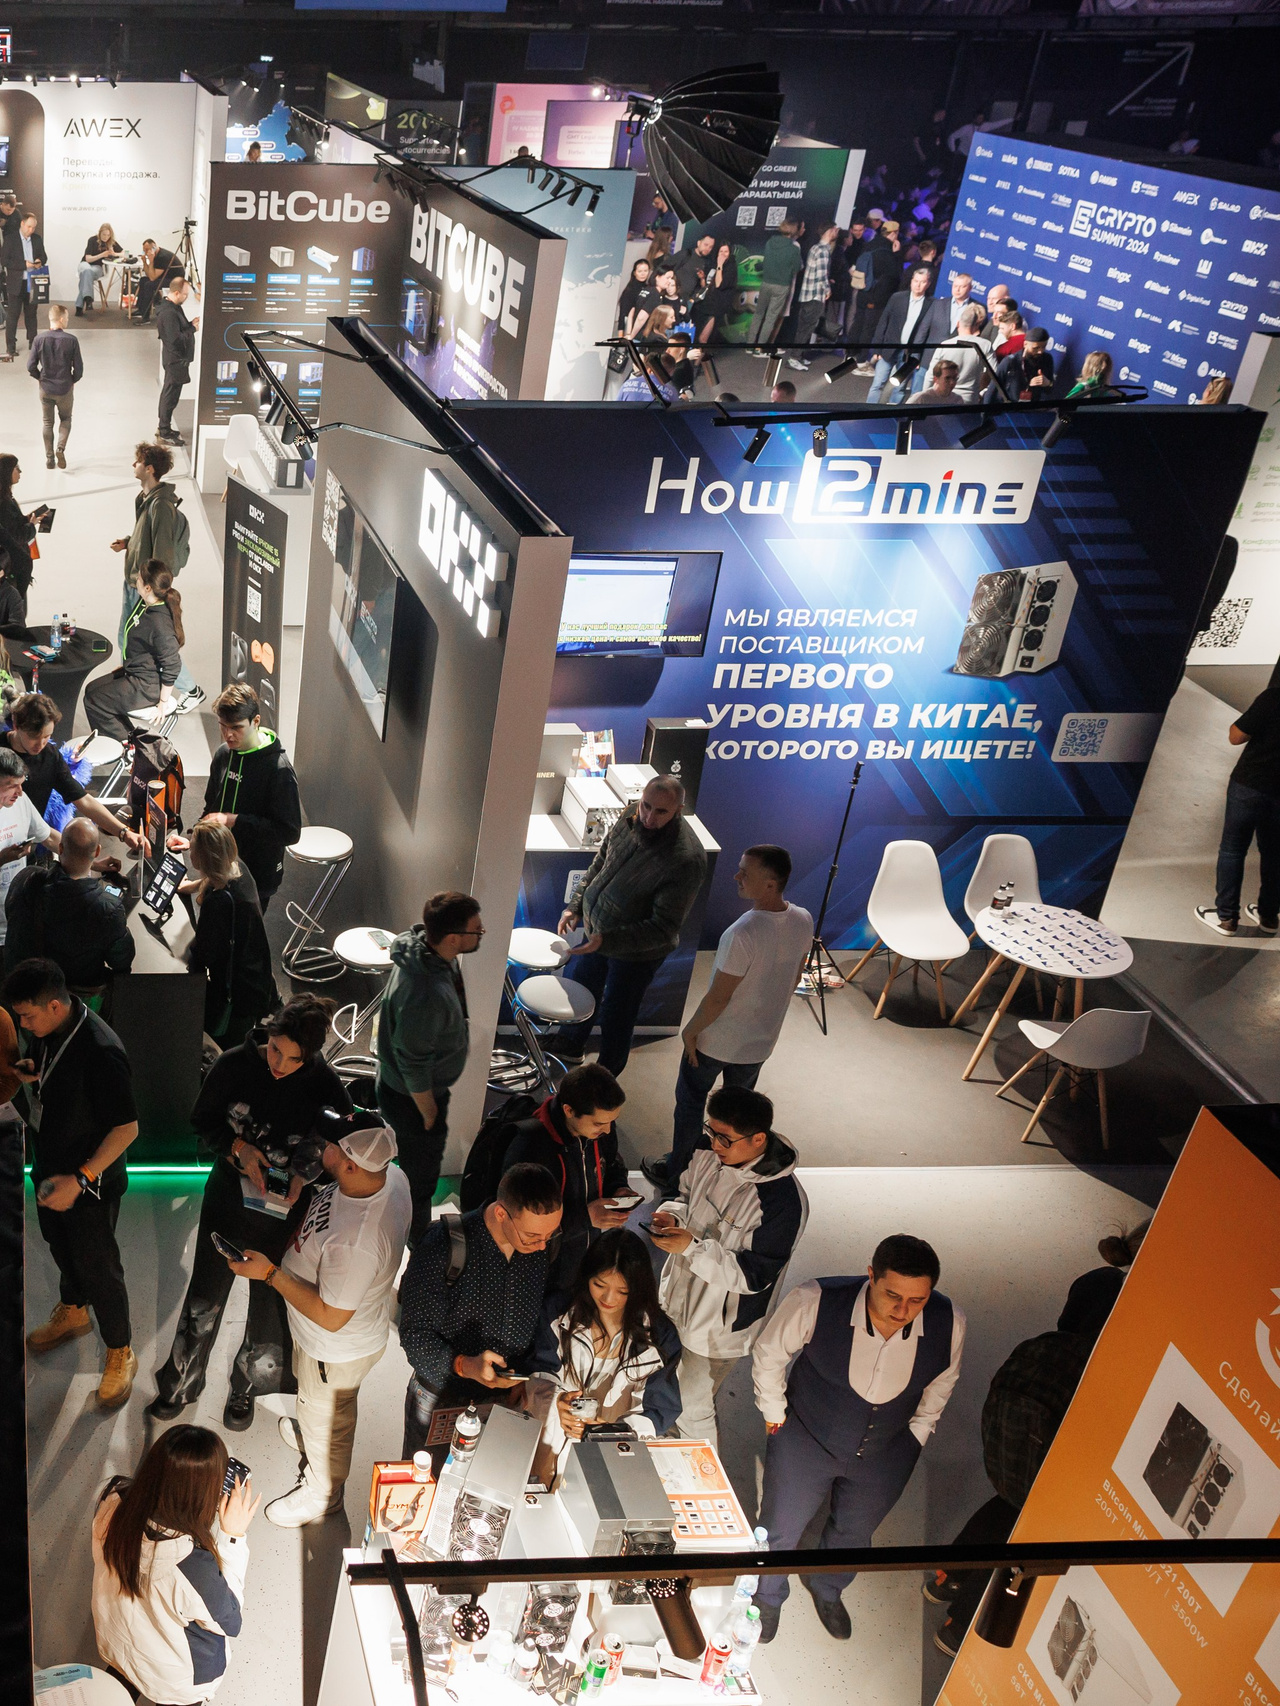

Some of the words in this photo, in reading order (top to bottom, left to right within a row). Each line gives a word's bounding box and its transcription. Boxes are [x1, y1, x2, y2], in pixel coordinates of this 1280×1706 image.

[63, 118, 142, 138] AWEX
[62, 170, 103, 181] Покупка
[114, 172, 161, 180] продажа.
[781, 181, 808, 189] ЧИЩЕ
[226, 190, 391, 223] BitCube
[1095, 205, 1157, 238] CRYPTO
[1090, 228, 1127, 249] SUMMIT
[1125, 238, 1150, 255] 2024
[409, 203, 526, 339] BITCUBE
[249, 503, 265, 524] OKX
[419, 467, 500, 639] OKX
[724, 608, 769, 627] МЫ
[776, 608, 918, 628] ЯВЛЯЕМСЯ
[719, 636, 926, 657] ПОСТАВЩИКОМ
[712, 663, 894, 689] ПЕРВОГО
[705, 703, 865, 729] УРОВНЯ
[873, 703, 900, 728] В
[908, 703, 1044, 733] КИТАЕ,
[865, 740, 912, 760] ВЫ
[920, 740, 1035, 763] ИЩЕТЕ!
[1102, 1479, 1133, 1524] Bitcoin
[1177, 1580, 1203, 1615] 200T
[1094, 1493, 1119, 1525] 200T
[1171, 1600, 1209, 1649] 3500W
[1016, 1662, 1035, 1690] CKB
